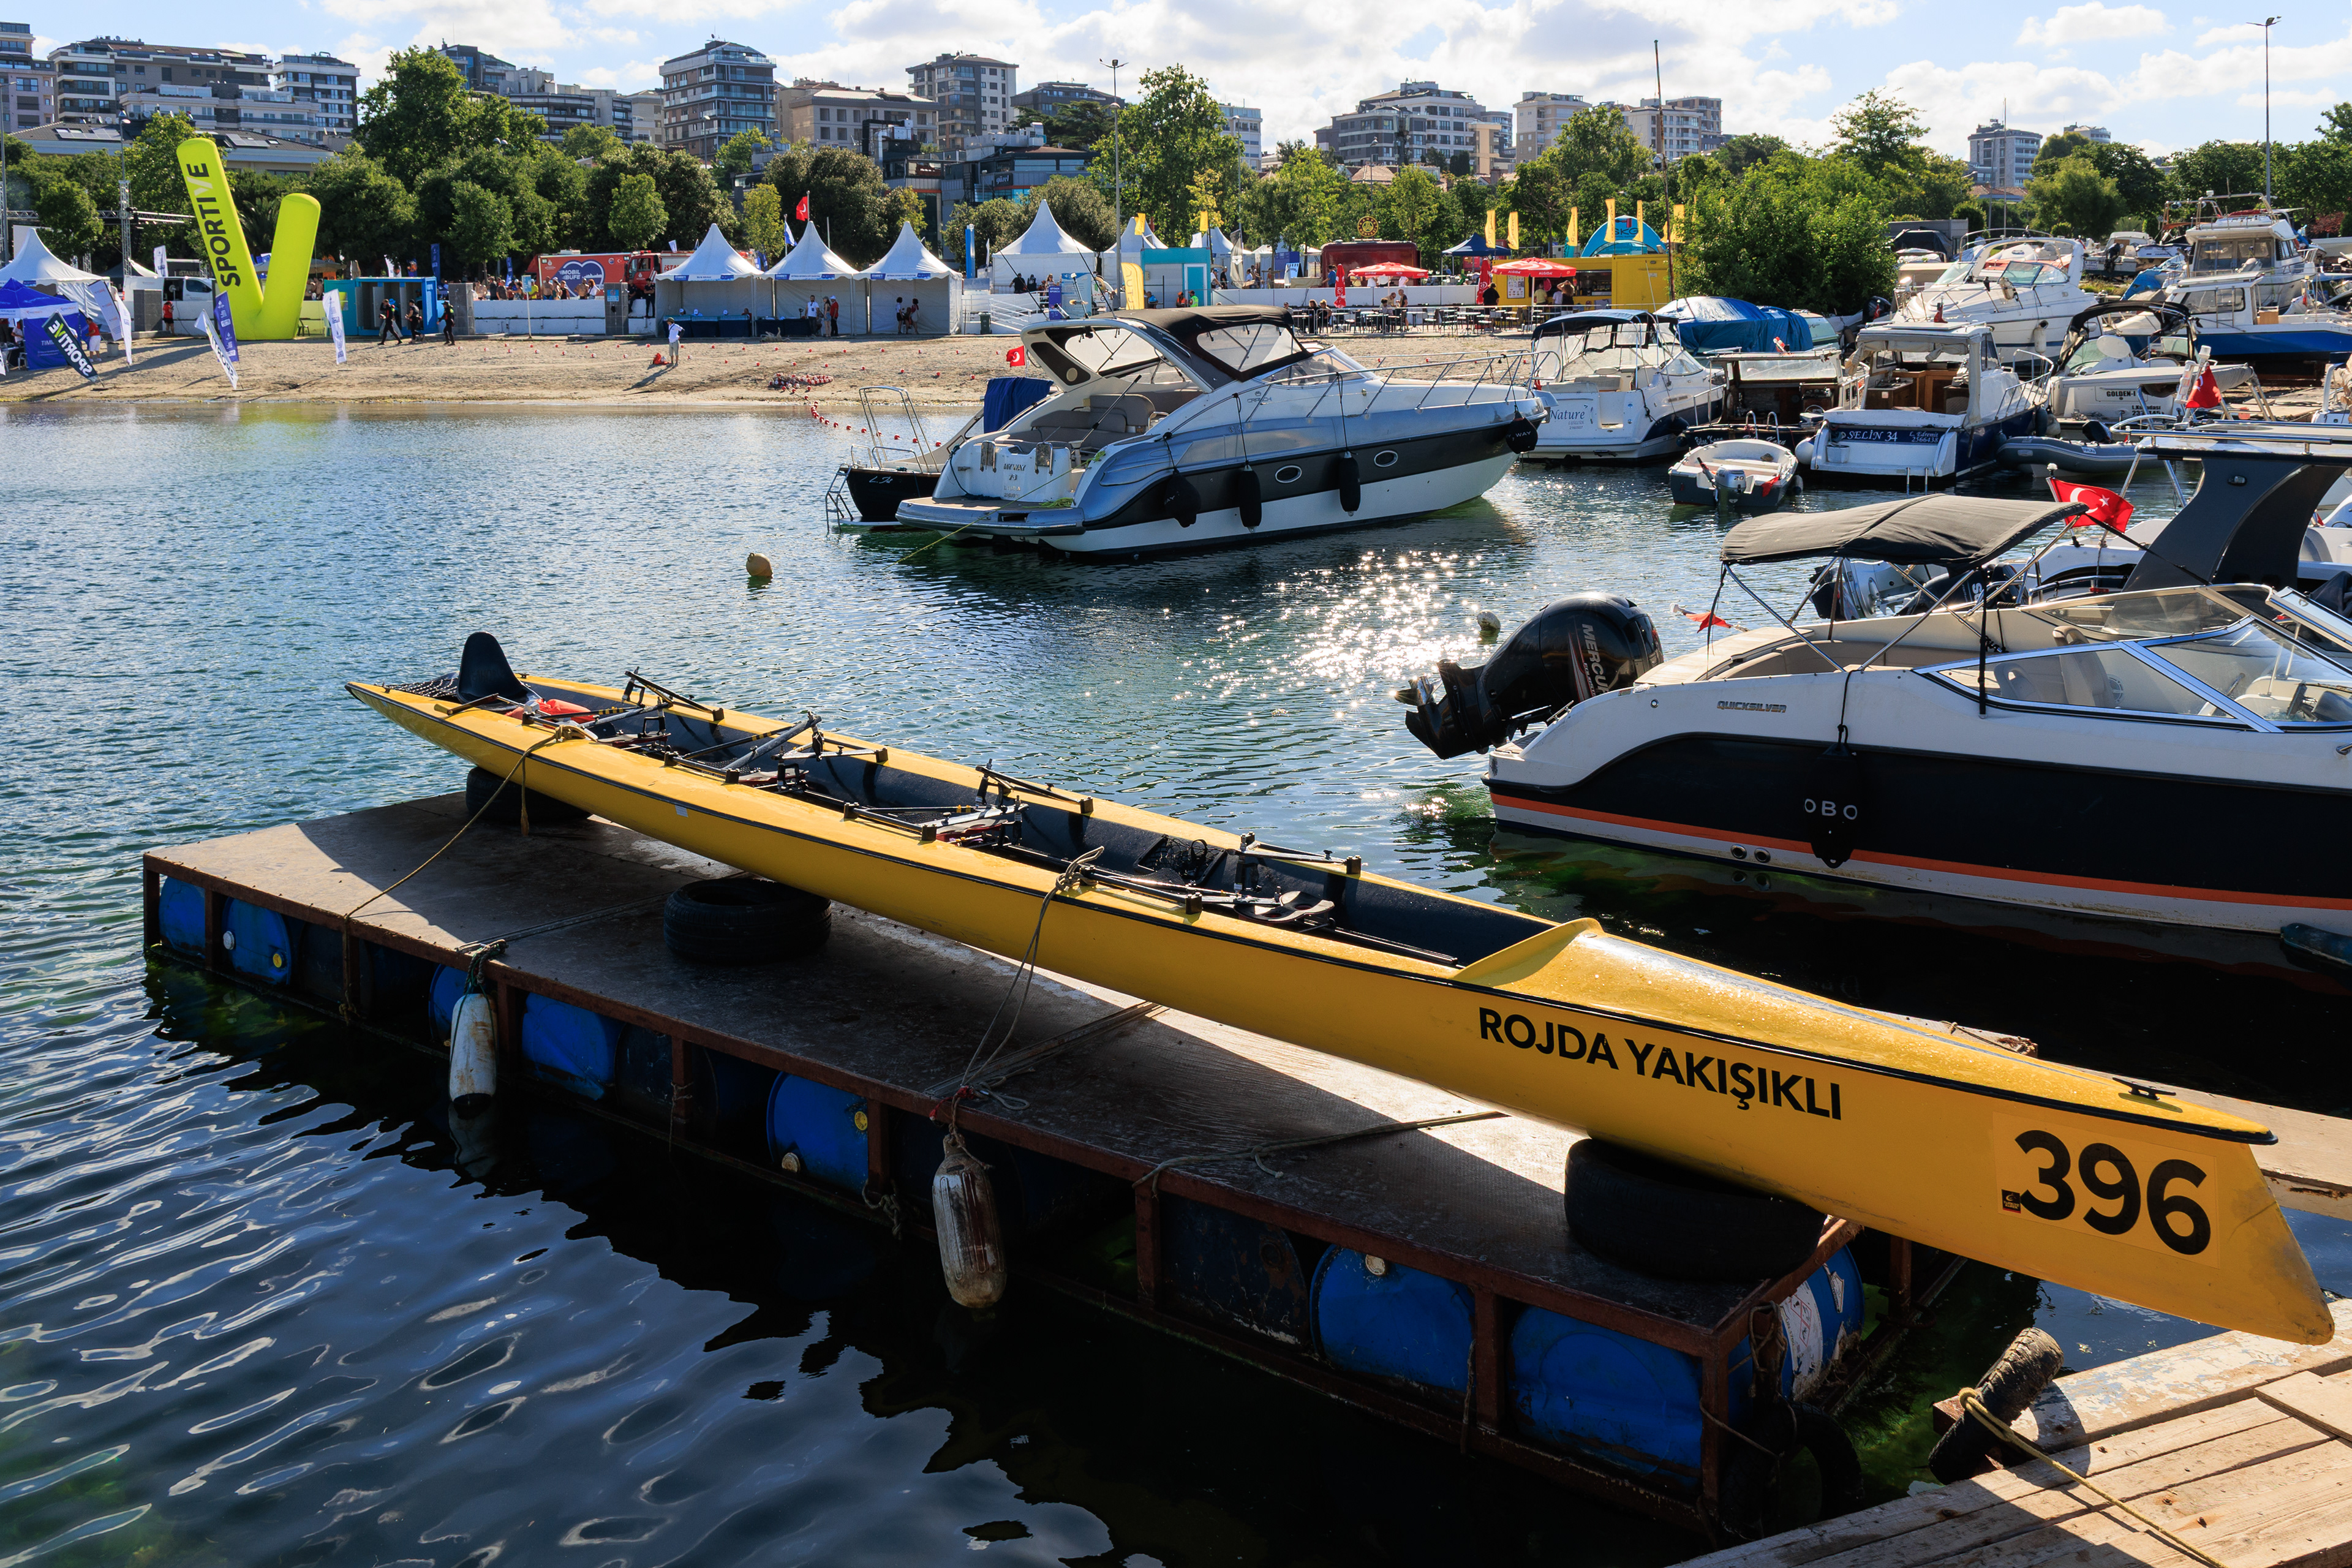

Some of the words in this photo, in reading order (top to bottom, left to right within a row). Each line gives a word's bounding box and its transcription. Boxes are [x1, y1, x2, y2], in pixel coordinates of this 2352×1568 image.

[996, 175, 1009, 185] güzel
[186, 163, 241, 287] SPORTIVE
[1550, 409, 1585, 420] Nature
[1847, 429, 1883, 440] SELİN
[1885, 431, 1898, 442] 34
[1717, 701, 1787, 713] QUICKSILVER
[1479, 1007, 1619, 1070] ROJDA
[1624, 1038, 1841, 1121] YAKIŞIKLI
[2015, 1129, 2211, 1256] 396
